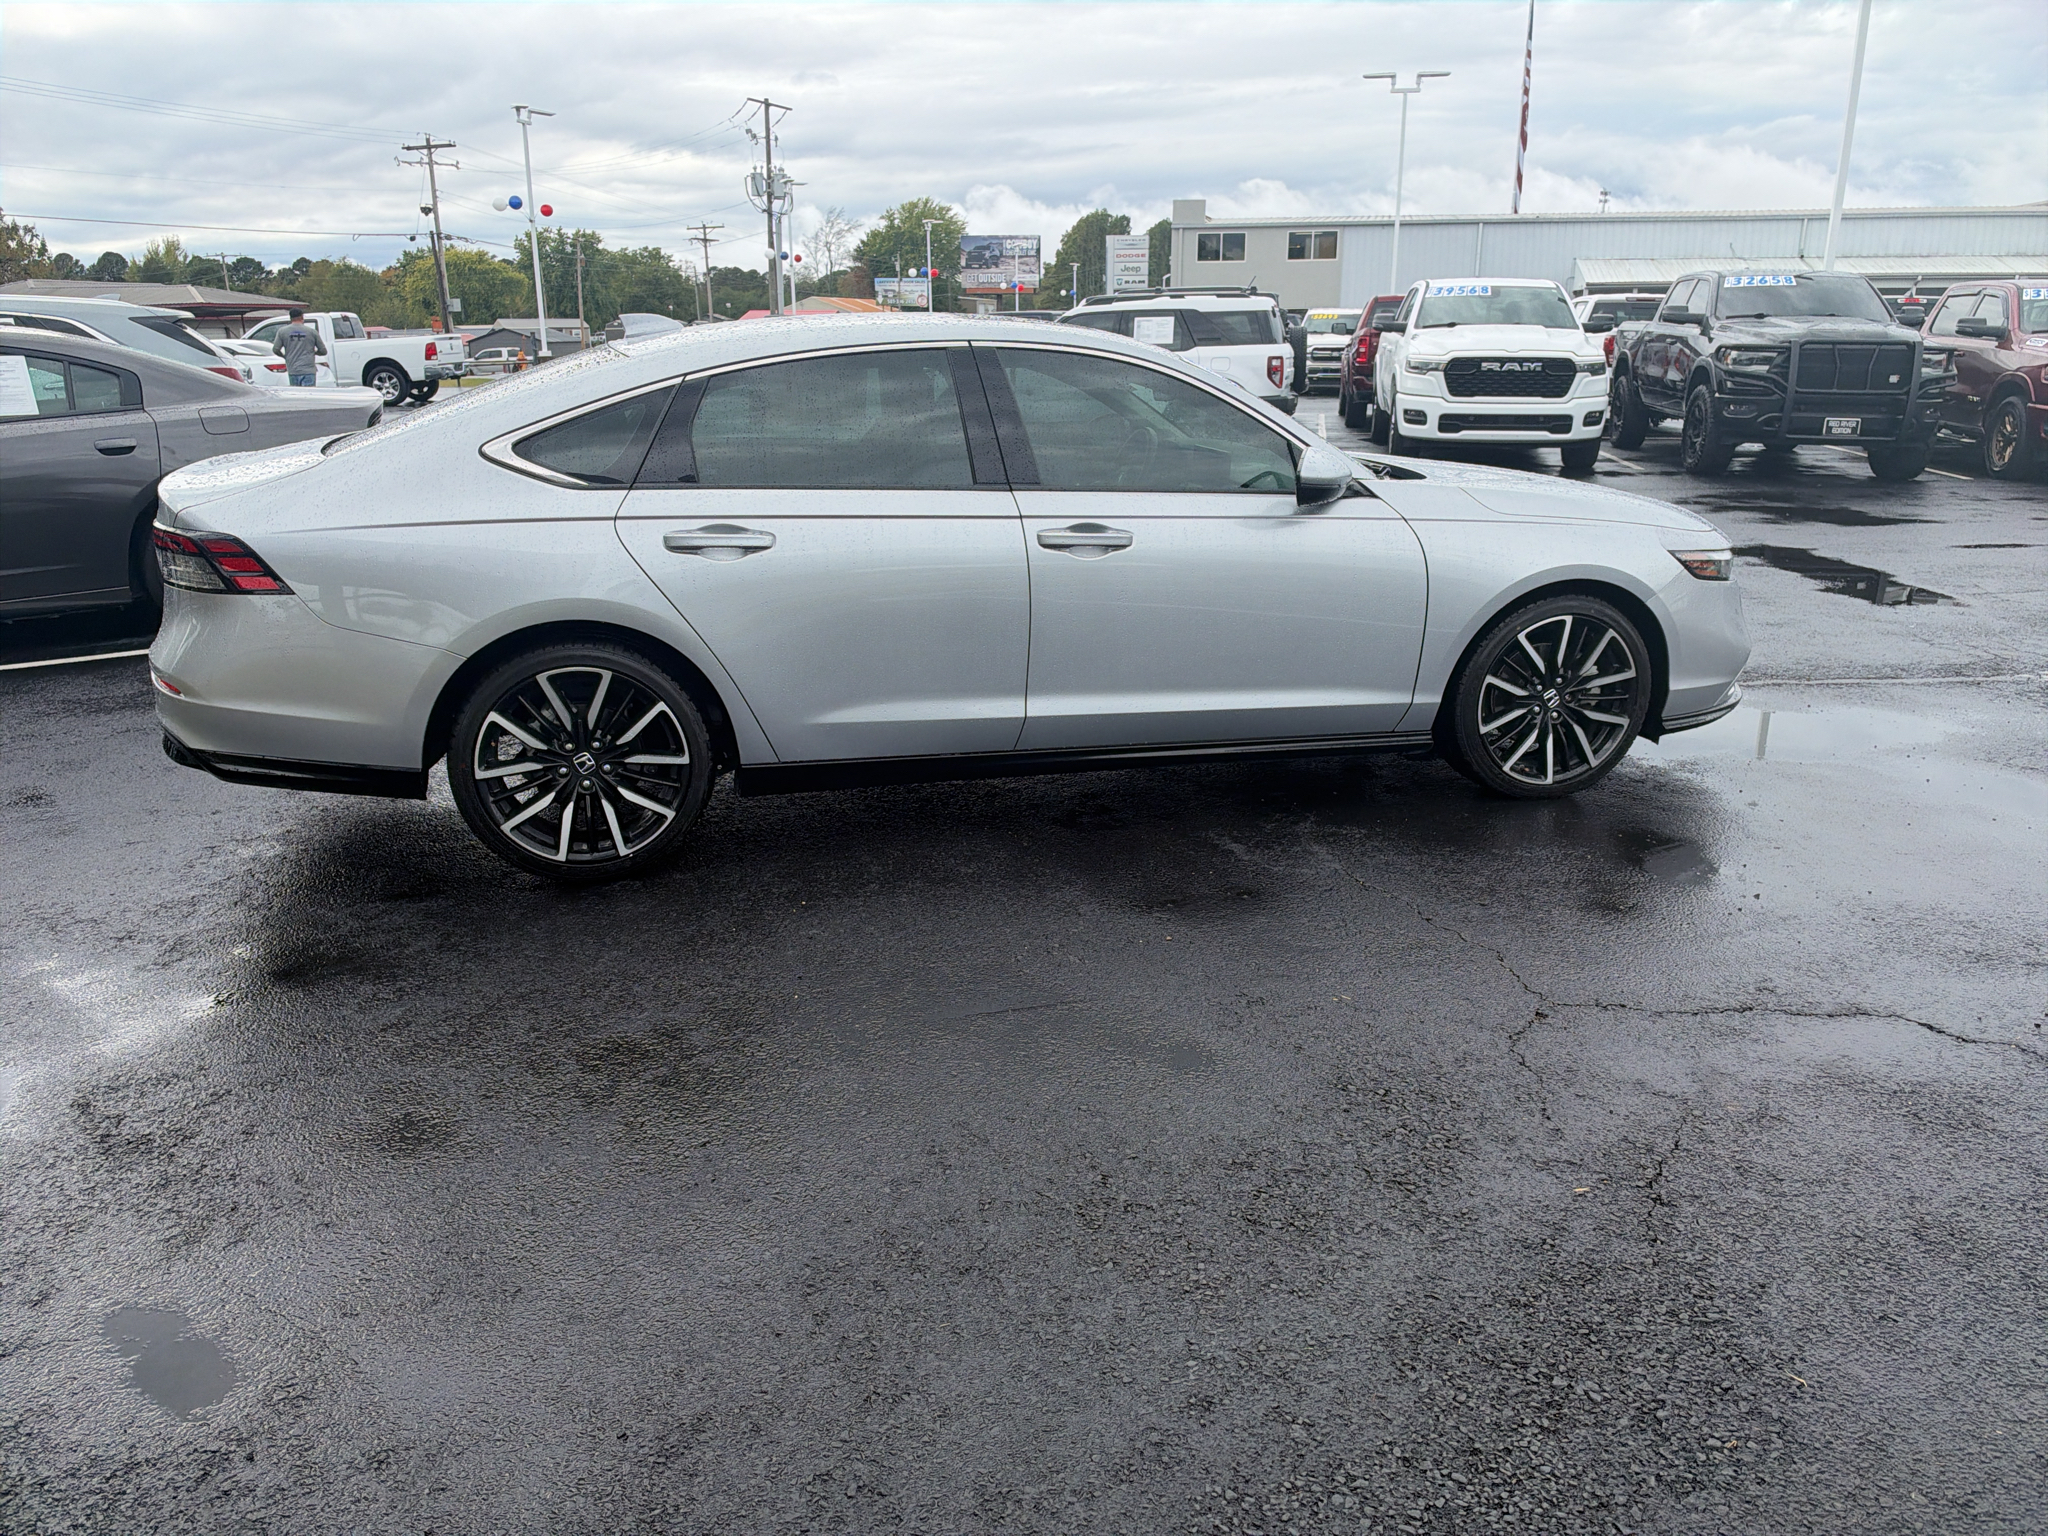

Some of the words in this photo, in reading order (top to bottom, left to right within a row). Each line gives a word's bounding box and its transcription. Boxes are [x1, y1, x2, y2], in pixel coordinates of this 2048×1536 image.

[1120, 264, 1141, 274] Jeep
[967, 273, 978, 283] GET
[979, 273, 1006, 283] OUTSIDE
[1481, 362, 1543, 371] RAM
[1840, 420, 1857, 428] RIVER
